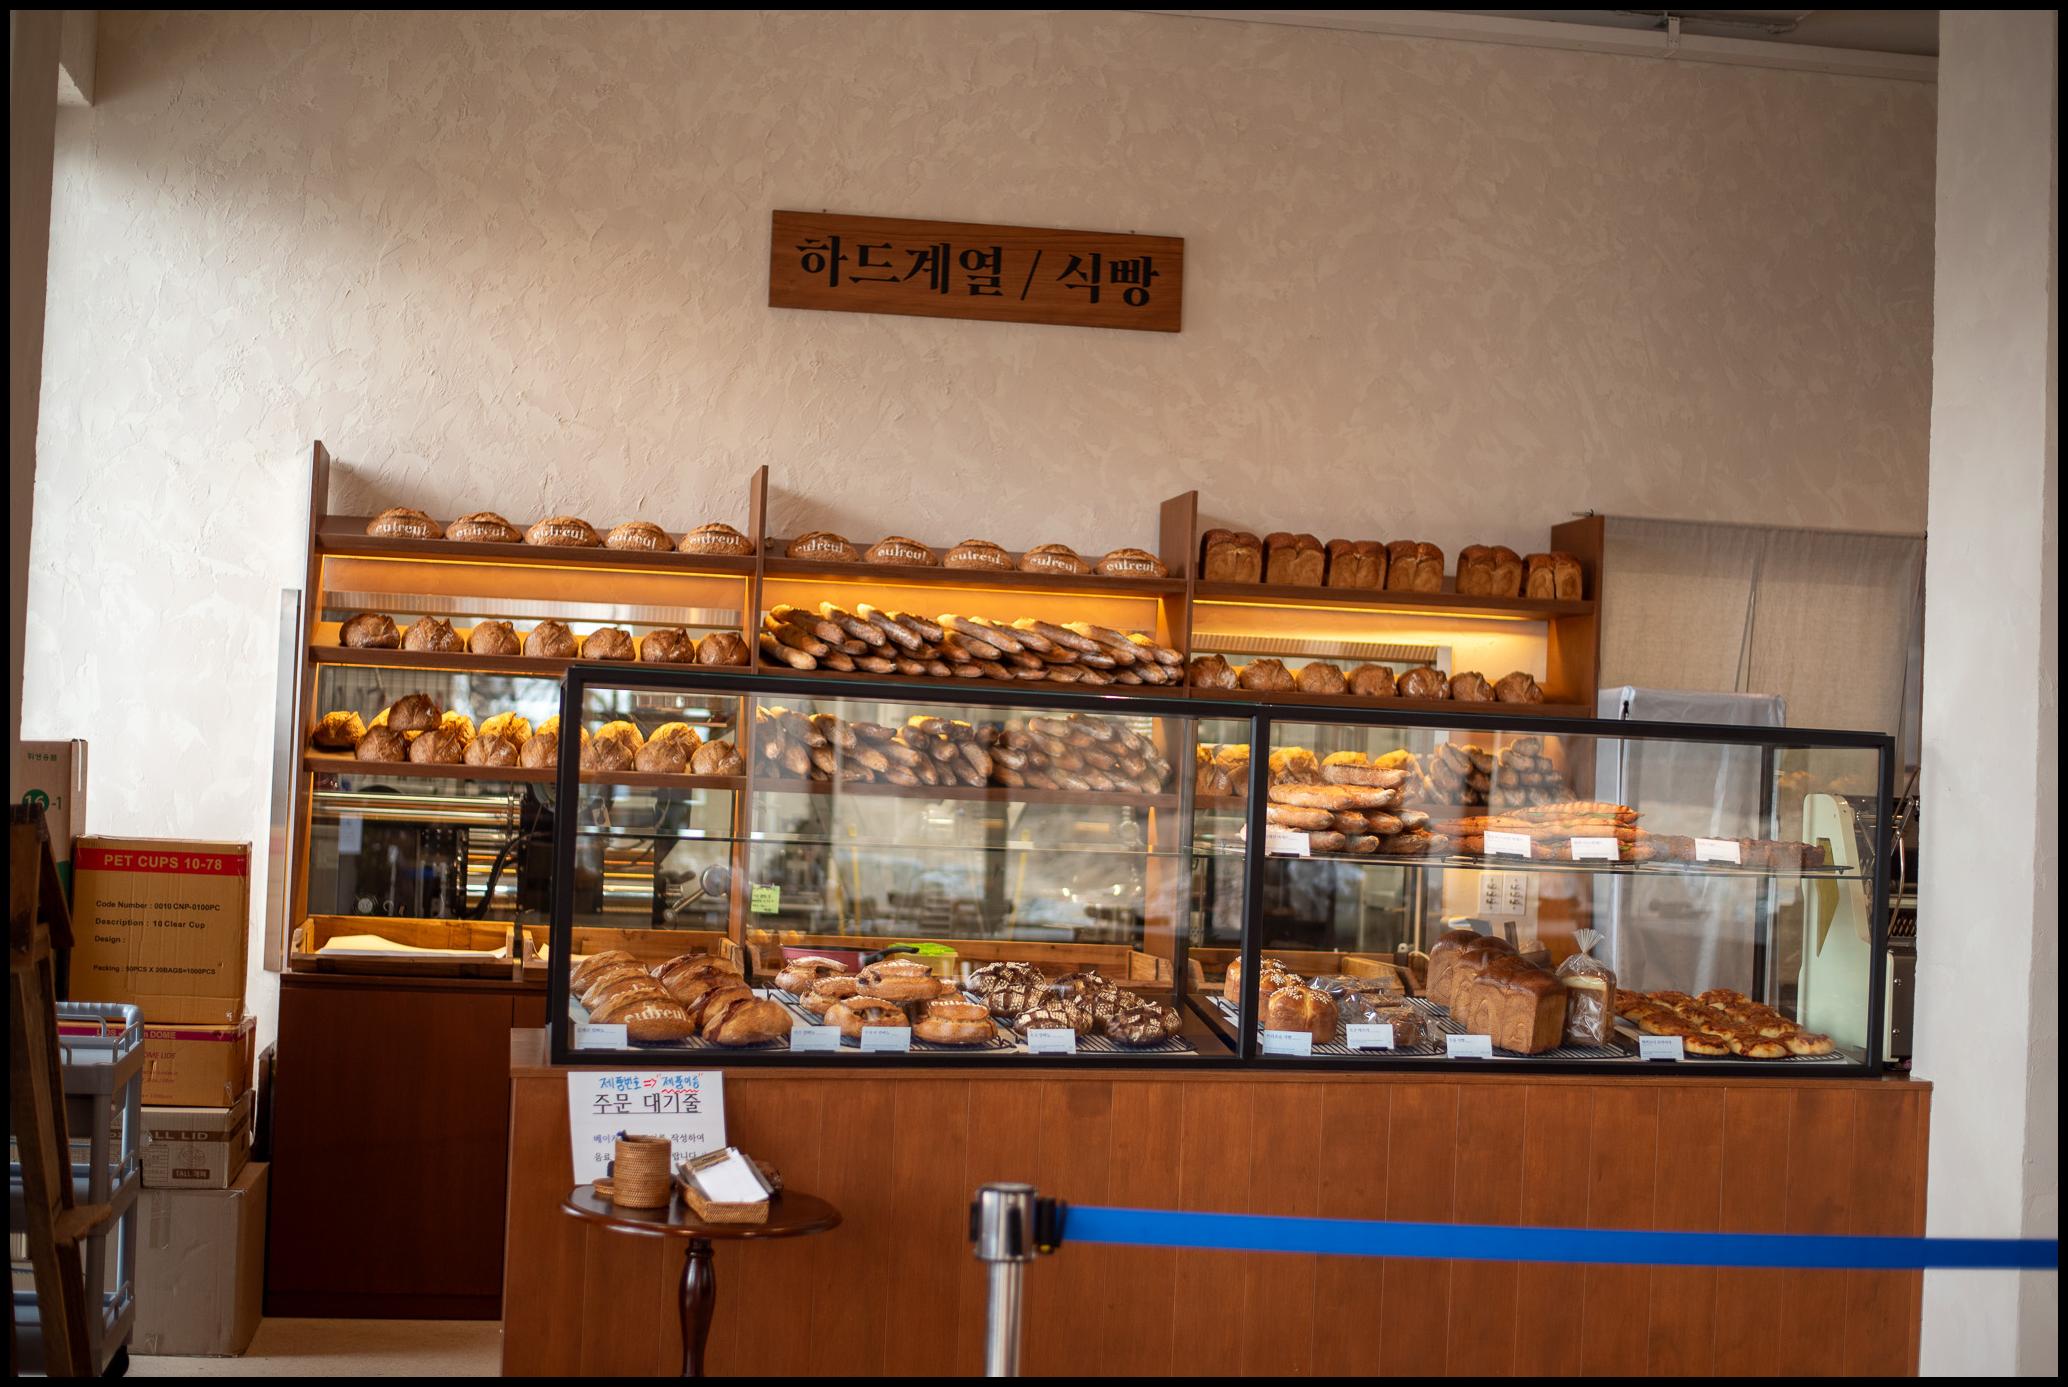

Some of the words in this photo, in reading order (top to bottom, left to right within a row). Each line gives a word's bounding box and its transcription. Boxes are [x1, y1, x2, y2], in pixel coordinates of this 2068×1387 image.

[796, 235, 1003, 298] 하드계열
[1020, 249, 1042, 301] /
[1055, 252, 1160, 308] 식빵
[104, 854, 133, 867] PET
[138, 856, 179, 869] CUPS
[184, 858, 223, 871] 10-78
[96, 900, 116, 908] Code
[117, 901, 147, 909] Number
[154, 902, 172, 910] 0010
[95, 918, 144, 927] Description
[164, 920, 186, 928] Clear
[188, 921, 206, 930] Cup
[94, 935, 121, 944] Design
[93, 964, 120, 973] Packing
[150, 1031, 176, 1040] DOME
[599, 1075, 642, 1092] 제품번호
[593, 1093, 632, 1113] 주문
[643, 1092, 701, 1113] 대기줄
[181, 1131, 209, 1141] LID
[671, 1133, 705, 1144] 작성하여
